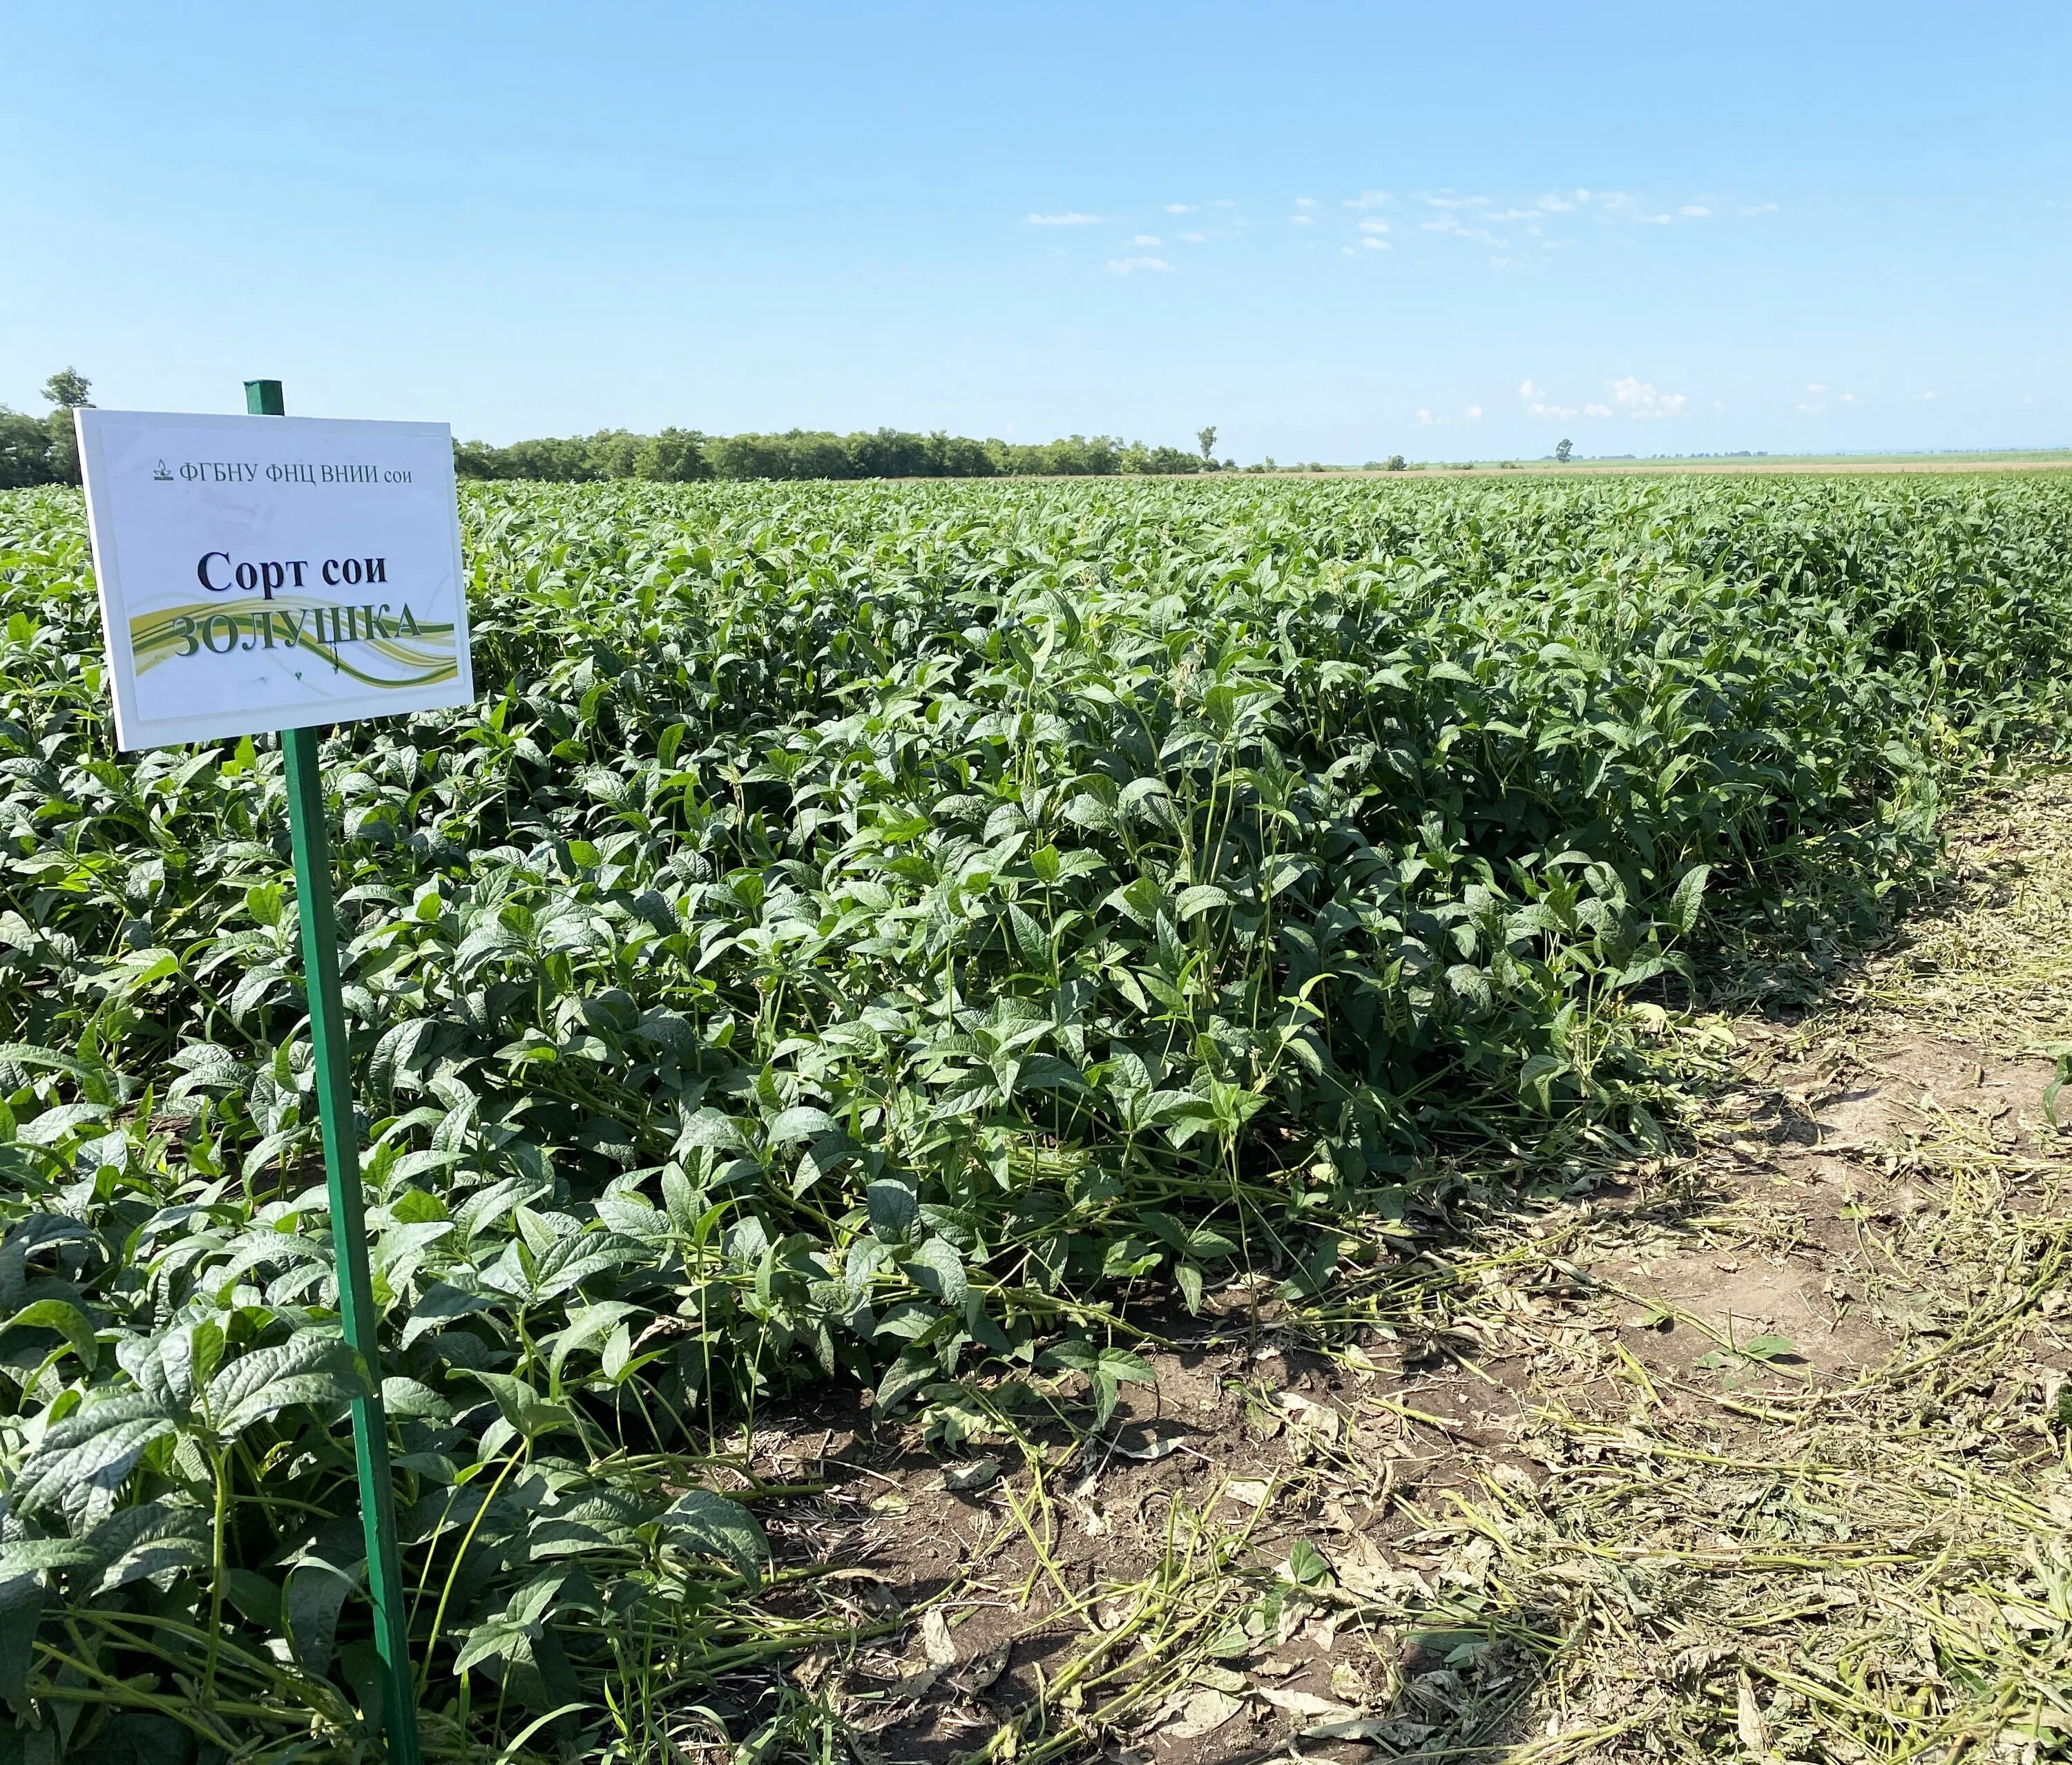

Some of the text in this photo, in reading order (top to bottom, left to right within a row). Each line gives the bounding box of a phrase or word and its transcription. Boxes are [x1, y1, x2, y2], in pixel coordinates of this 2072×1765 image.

[180, 461, 413, 486] ФГБНУ ФНЦ ВНИИ сои
[197, 551, 387, 600] Сорт сои
[172, 602, 423, 657] ЗОЛУШКА
